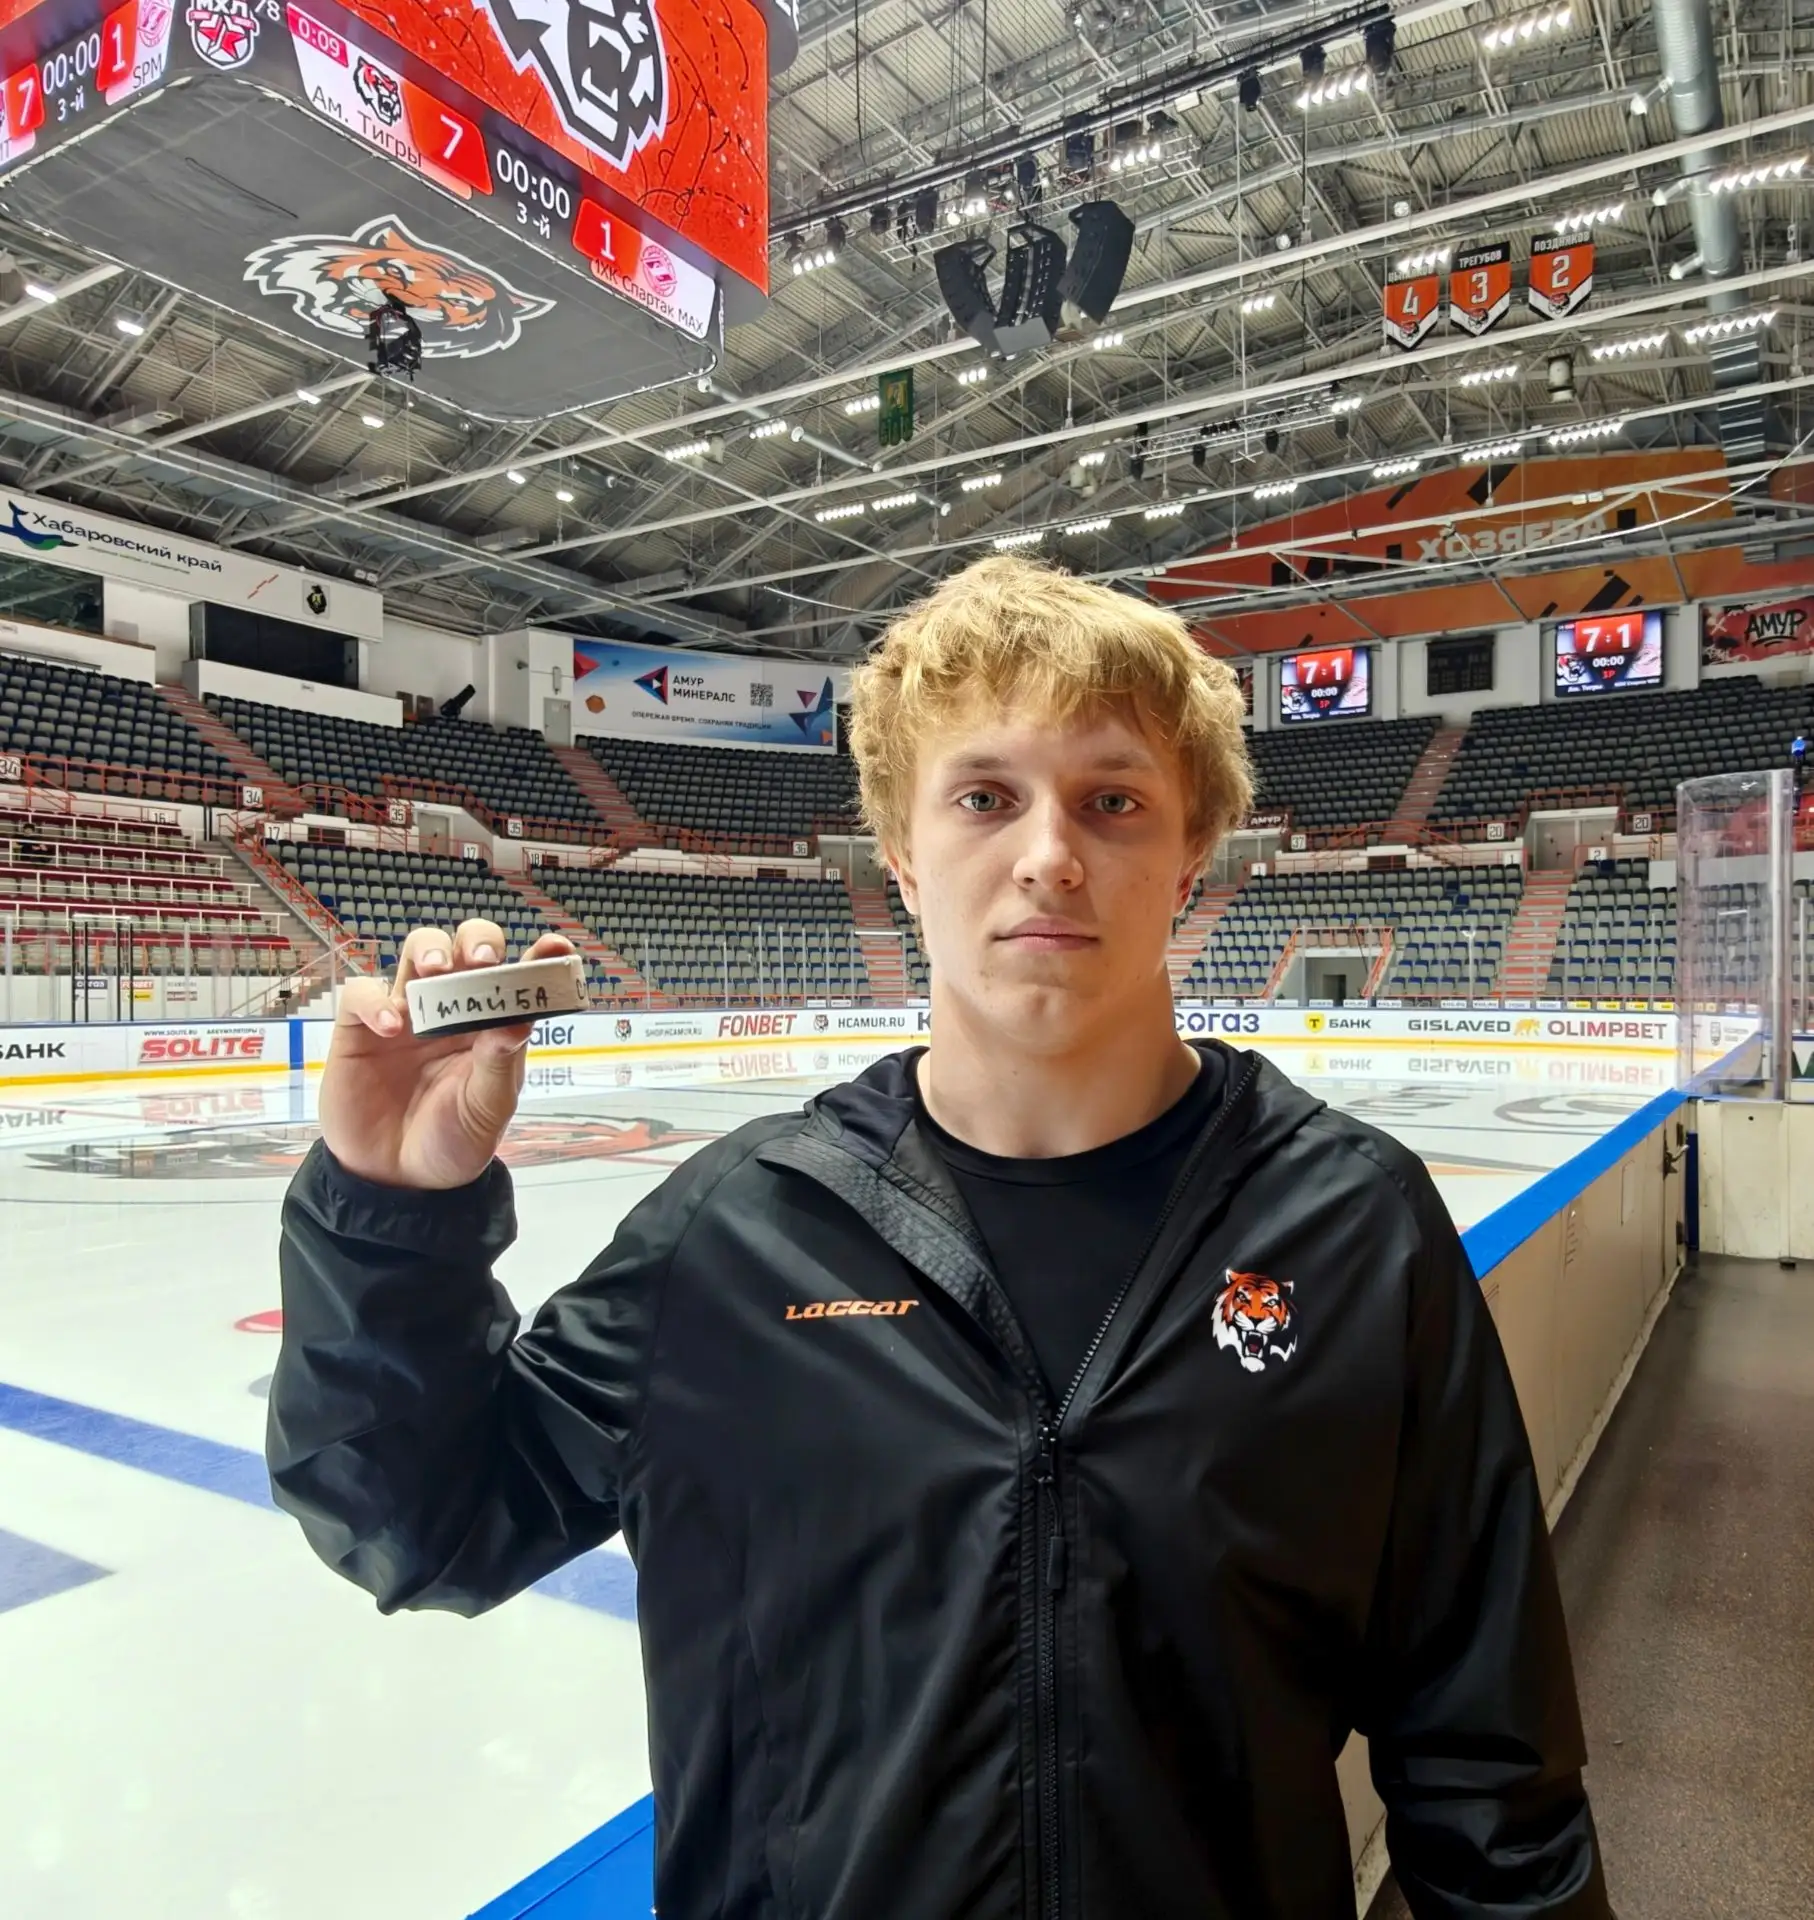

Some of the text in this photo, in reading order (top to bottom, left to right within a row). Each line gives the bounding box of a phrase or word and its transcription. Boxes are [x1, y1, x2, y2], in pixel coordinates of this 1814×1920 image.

[111, 23, 127, 73] 1
[298, 17, 341, 57] 0:09
[42, 32, 101, 95] 00:00
[132, 53, 163, 89] SPM
[18, 77, 35, 127] 7
[312, 85, 422, 168] Ам. Тигры
[440, 113, 464, 160] 7
[496, 149, 571, 219] 00:00
[600, 220, 616, 262] 1
[1534, 231, 1590, 252] ПОЗДНЯКОВ
[1459, 251, 1502, 268] ТРЕГУБОВ
[1552, 254, 1570, 288] 2
[621, 274, 675, 317] Спартак
[1471, 271, 1488, 304] 3
[1402, 286, 1419, 316] 4
[32, 511, 172, 560] Хабаровский
[177, 552, 223, 573] край
[1417, 517, 1607, 561] ХОЗЯЕВА
[1745, 608, 1808, 640] АМУР
[1592, 655, 1625, 667] 00:00
[673, 675, 704, 687] АМУР
[673, 688, 736, 703] МИНЕРАЛС
[245, 789, 261, 804] 34
[391, 807, 403, 822] 35
[1635, 817, 1649, 829] 20
[268, 826, 280, 841] 17
[509, 821, 521, 835] 35
[1490, 826, 1502, 838] 20
[1292, 837, 1304, 849] 37
[529, 1020, 574, 1045] aier
[718, 1014, 797, 1037] FONBET
[838, 1017, 905, 1028] HCAMUR.RU
[1329, 1019, 1371, 1028] БАНК
[1408, 1019, 1511, 1032] GISLAVED
[1547, 1020, 1667, 1039] OLIMPBET
[141, 1037, 264, 1059] SOLITE
